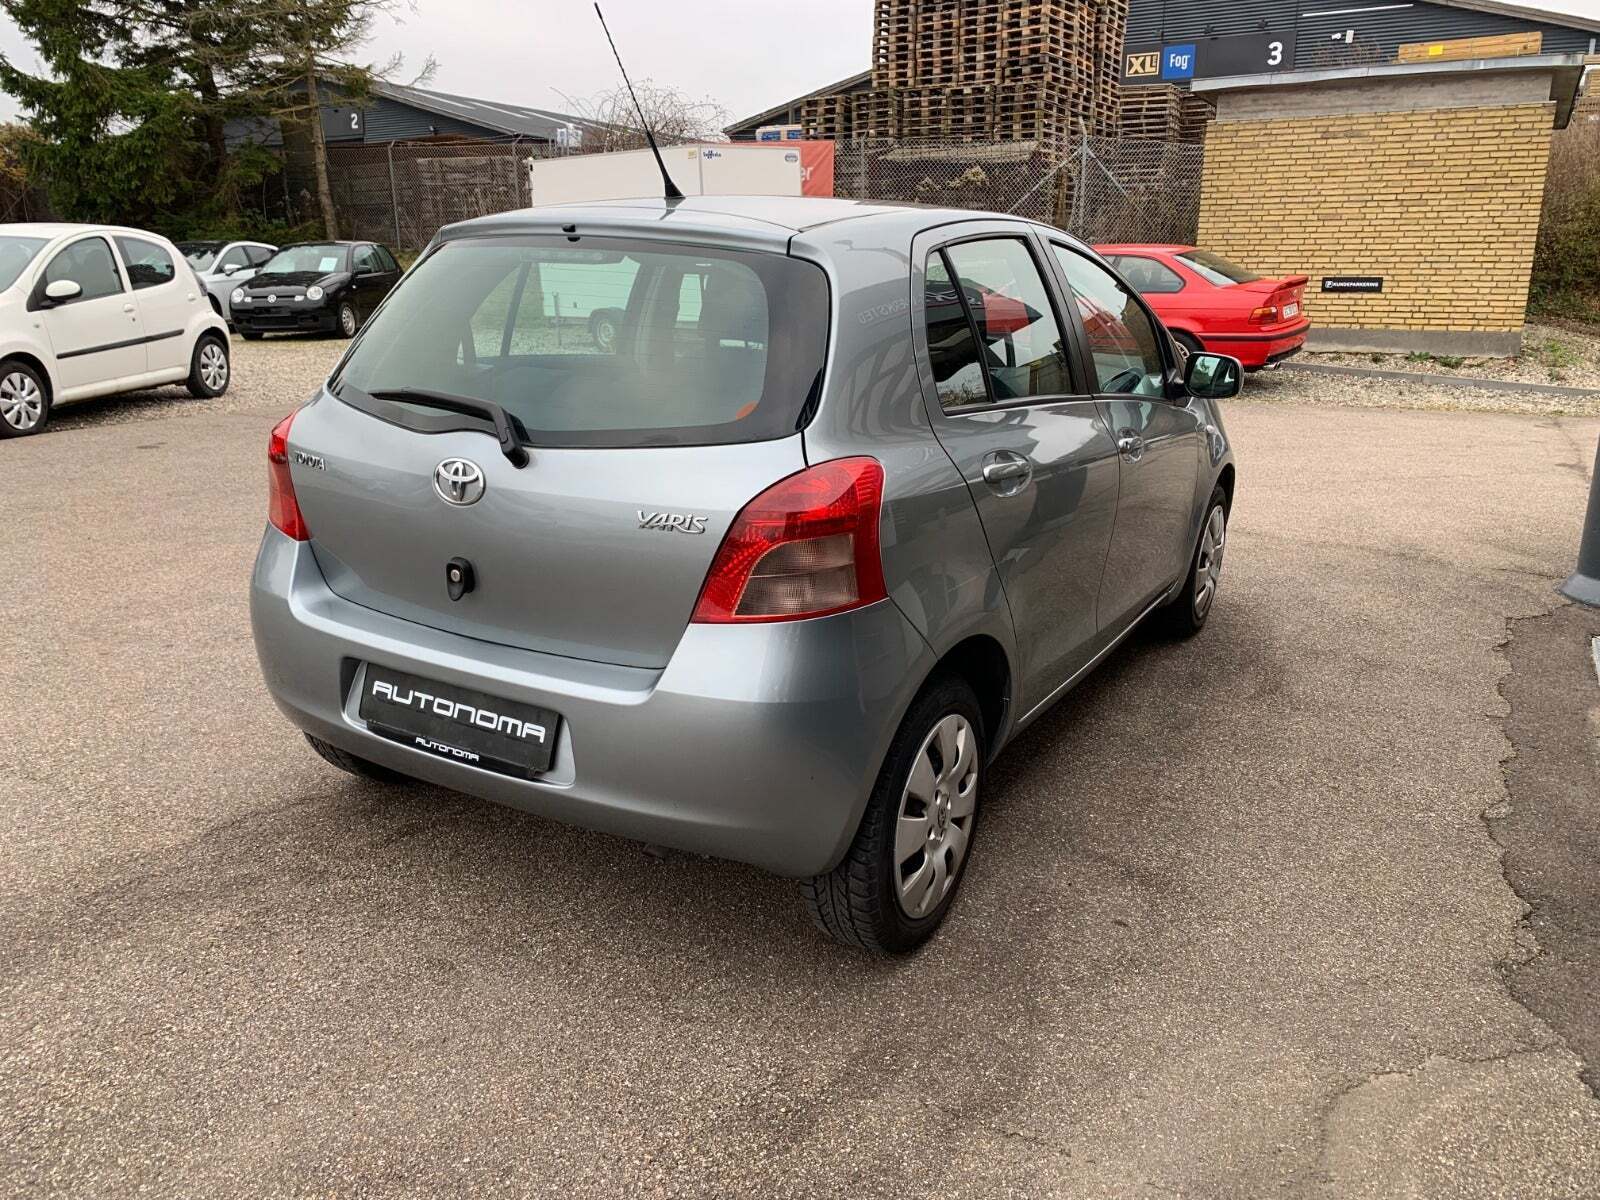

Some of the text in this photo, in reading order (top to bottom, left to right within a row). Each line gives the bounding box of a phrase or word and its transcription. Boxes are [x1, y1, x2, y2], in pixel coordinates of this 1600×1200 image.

[1170, 54, 1189, 70] Fog
[1267, 41, 1282, 65] 3
[1129, 55, 1157, 74] XL
[351, 113, 358, 128] 2
[294, 450, 327, 471] TOYOTA
[372, 680, 546, 744] AUTONOMA
[415, 736, 480, 762] AUTONOMA
